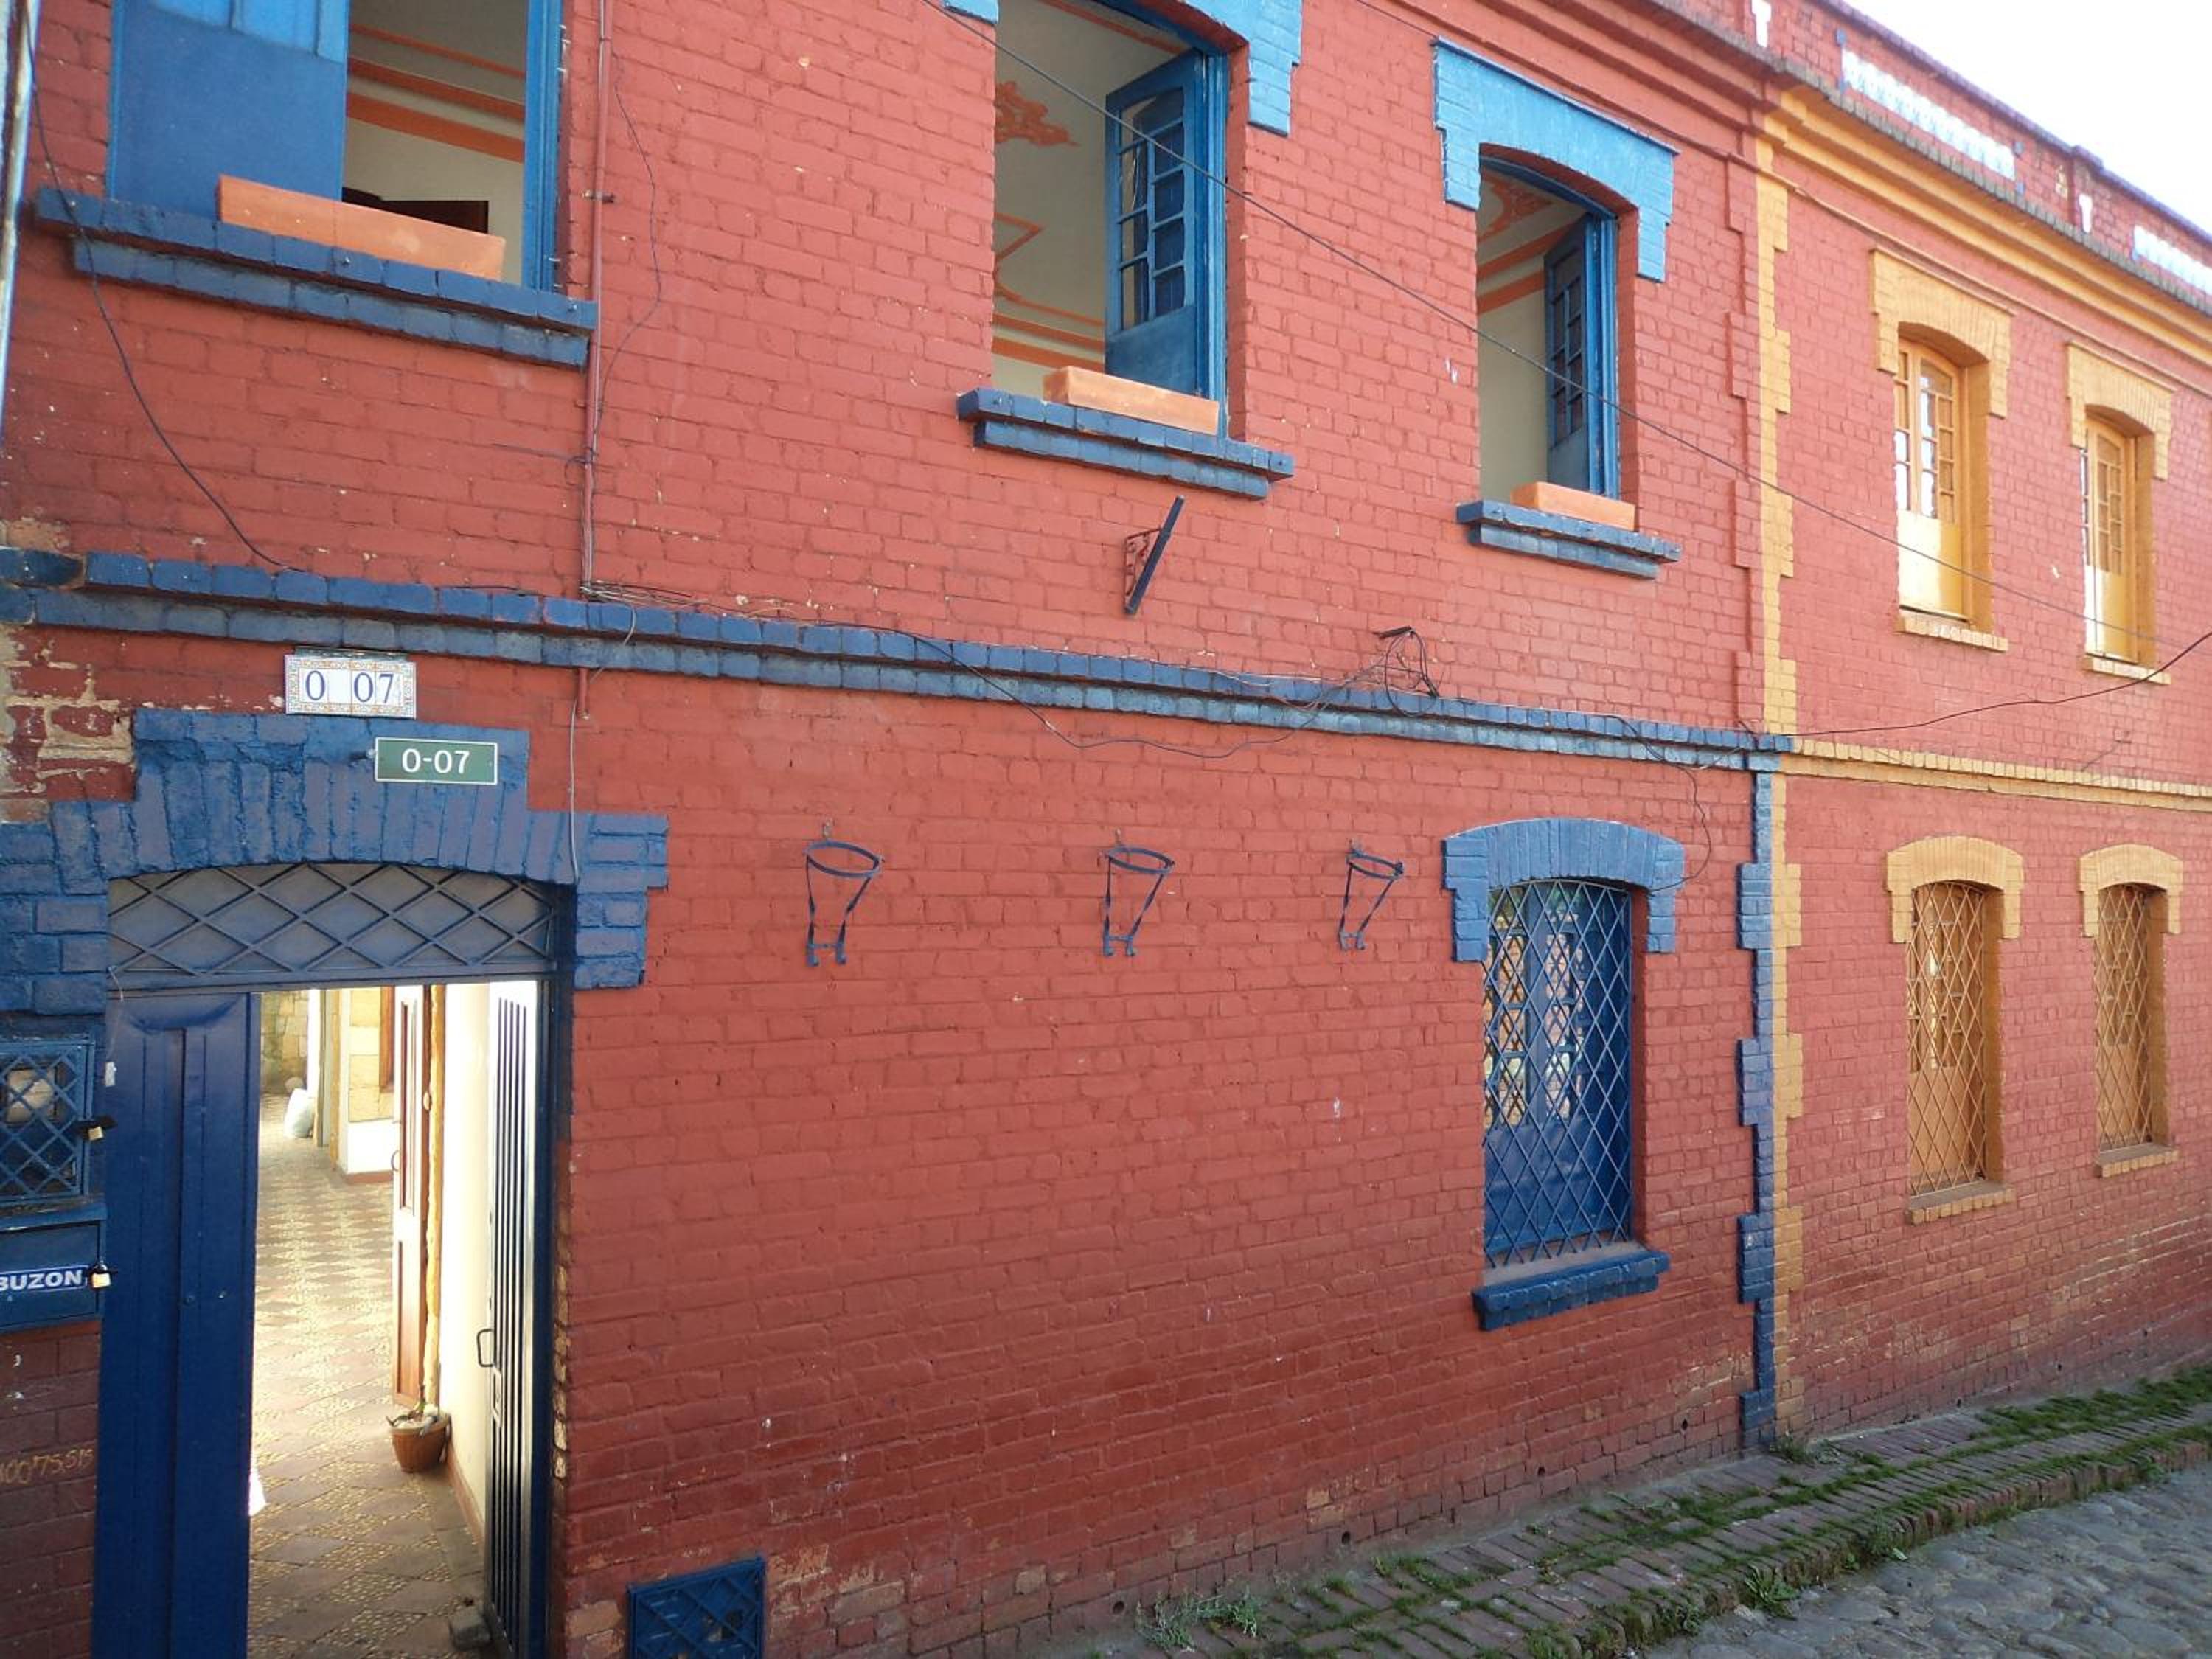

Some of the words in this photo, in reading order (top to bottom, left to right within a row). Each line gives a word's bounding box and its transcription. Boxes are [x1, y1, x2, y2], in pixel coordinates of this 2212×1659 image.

[305, 670, 326, 701] 0
[354, 672, 394, 703] 07
[402, 748, 470, 775] 0-07
